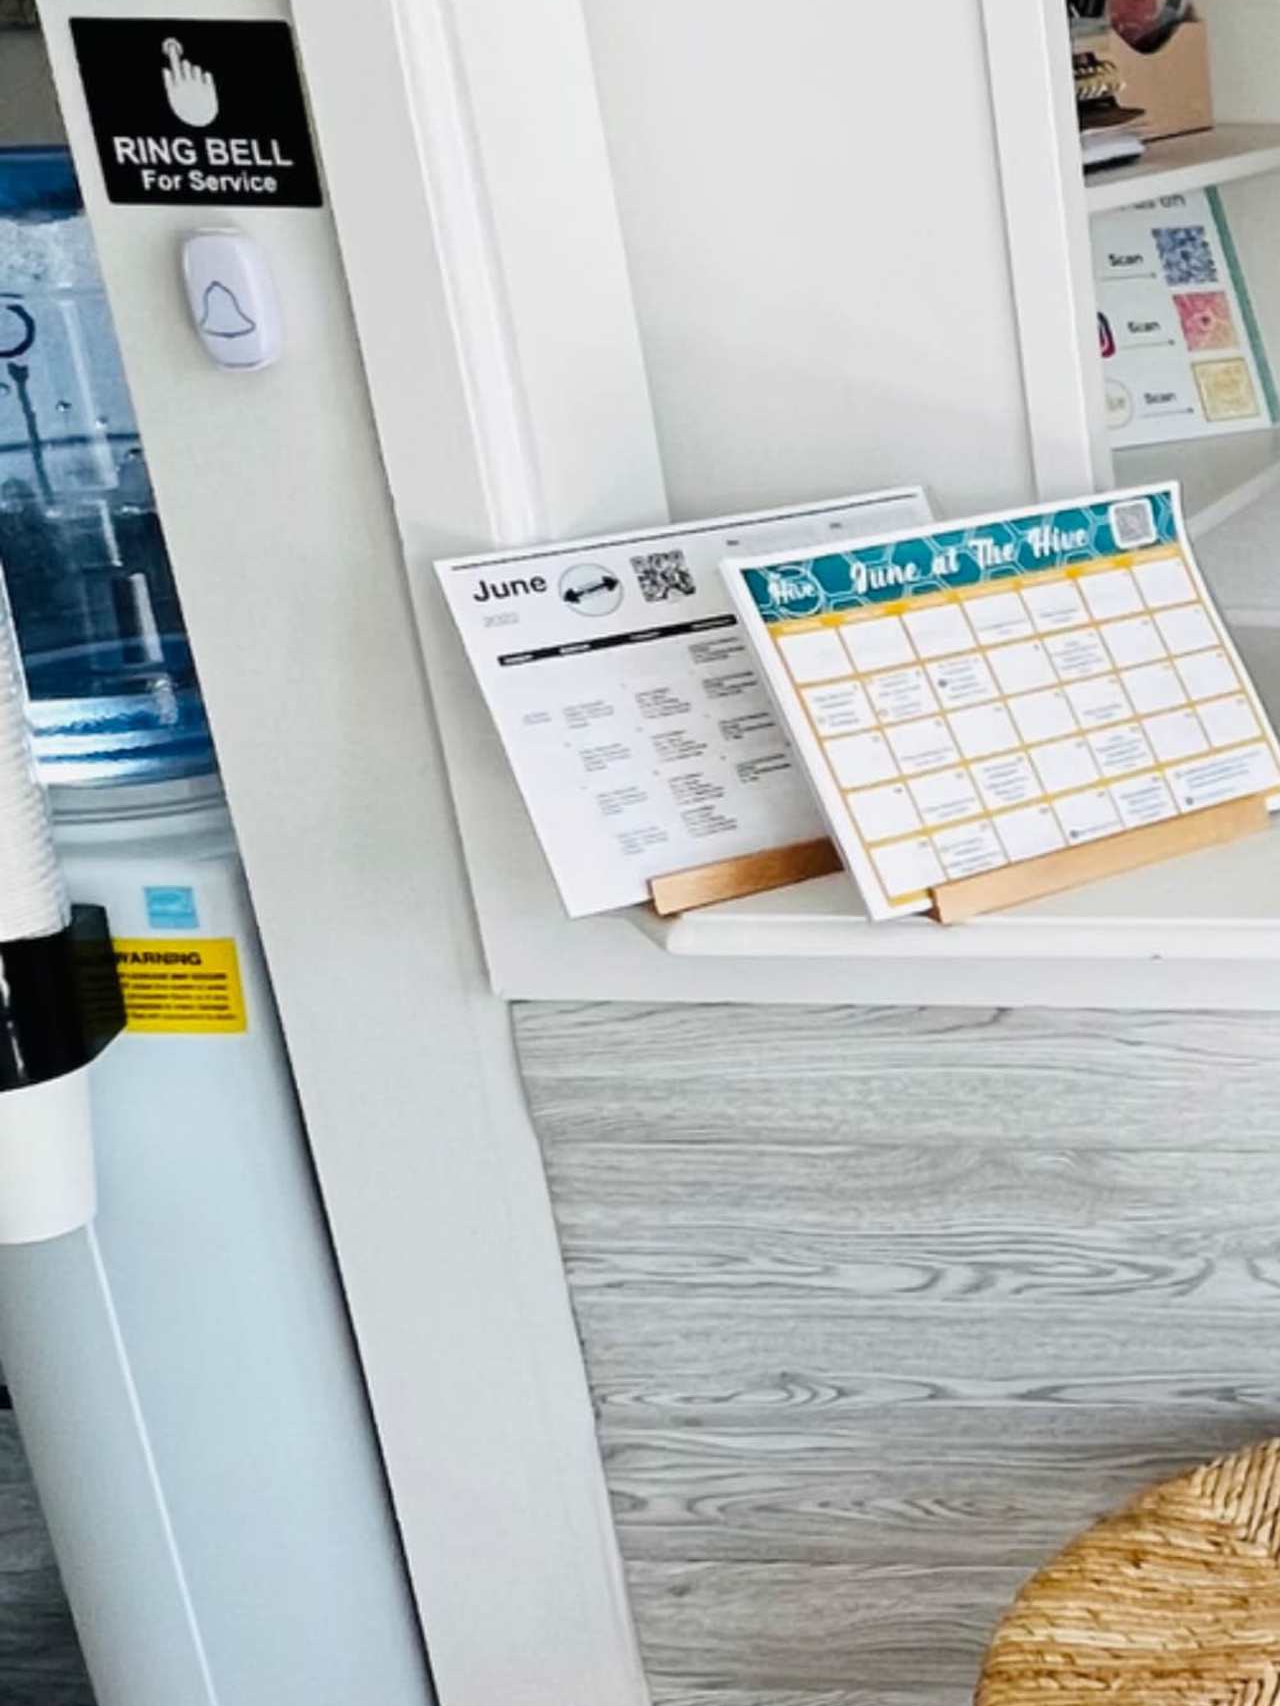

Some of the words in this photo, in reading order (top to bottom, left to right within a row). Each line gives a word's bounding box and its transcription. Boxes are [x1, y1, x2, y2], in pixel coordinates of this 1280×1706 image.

[112, 136, 198, 166] RING
[204, 138, 293, 166] BELL
[141, 169, 182, 192] For
[188, 170, 278, 193] Service
[1108, 253, 1144, 267] Scan
[1127, 321, 1161, 333] Scan
[1143, 392, 1177, 405] Scan
[850, 560, 922, 594] June
[932, 550, 959, 576] at
[968, 537, 1016, 568] The
[1025, 525, 1089, 558] Hive
[473, 575, 548, 602] June
[767, 576, 816, 606] Hive
